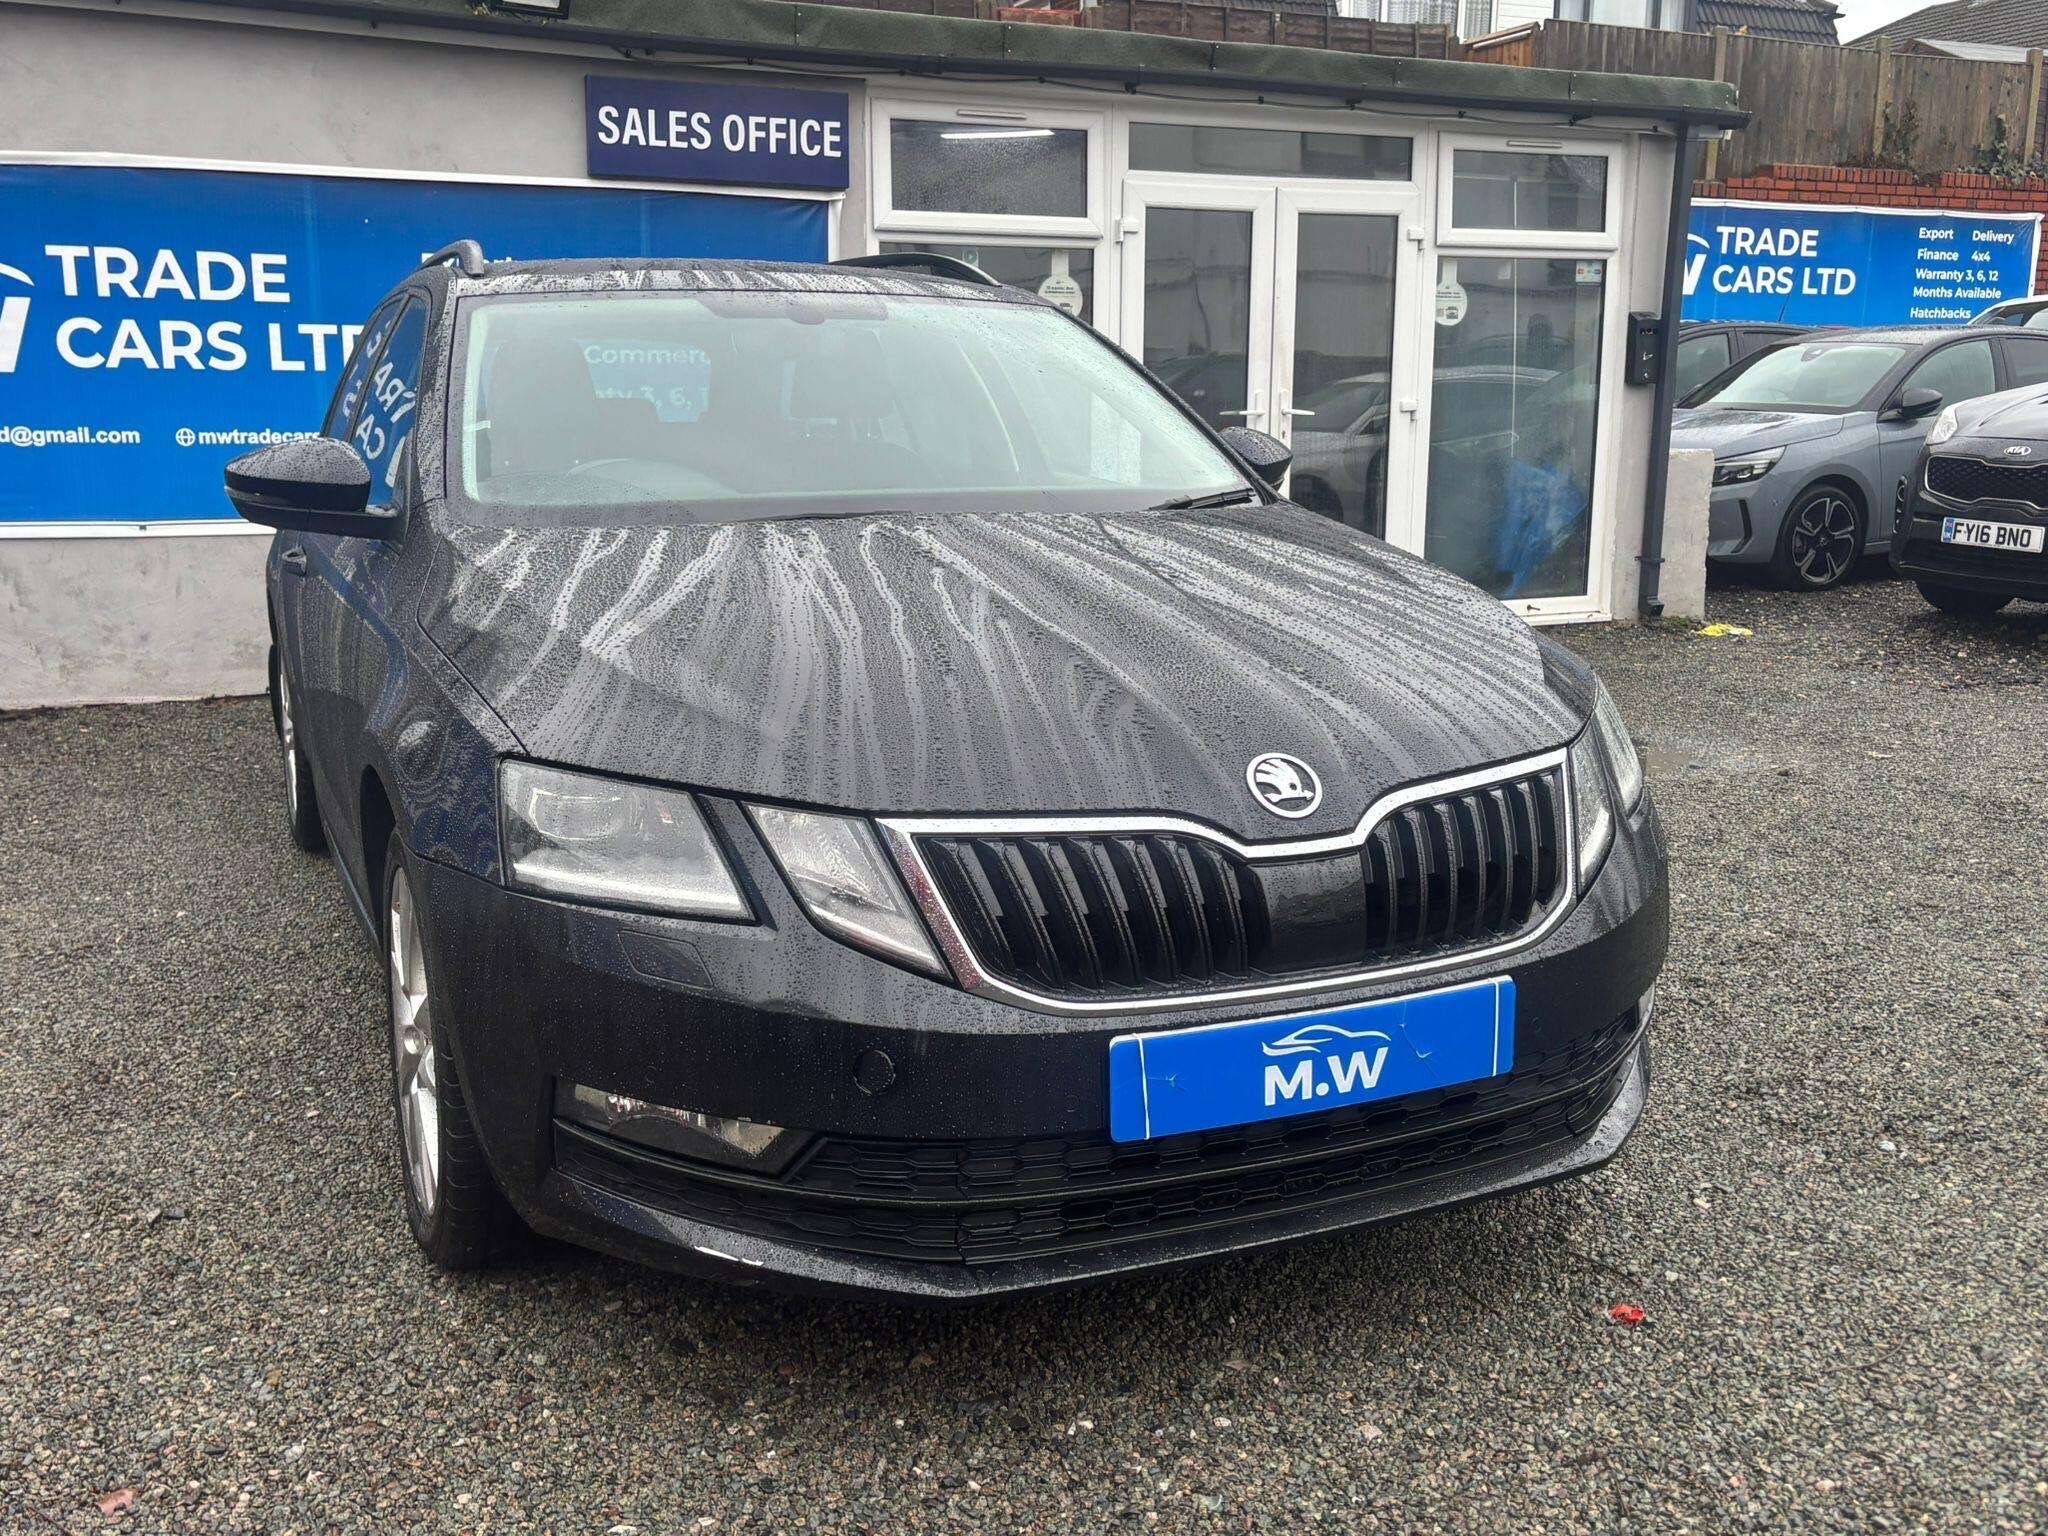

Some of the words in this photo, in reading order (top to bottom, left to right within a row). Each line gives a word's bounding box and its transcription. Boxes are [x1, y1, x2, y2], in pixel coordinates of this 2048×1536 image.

[598, 105, 712, 150] SALES
[722, 114, 842, 158] OFFICE
[1716, 225, 1820, 257] TRADE
[1918, 227, 1954, 241] Export
[1972, 230, 2015, 244] Delivery
[1917, 248, 1960, 261] Finance
[1971, 250, 1991, 262] 4x4
[45, 244, 291, 303] TRADE
[1712, 264, 1794, 295] CARS
[1802, 267, 1857, 296] LTD
[1915, 268, 1964, 282] Warranty
[1965, 269, 1975, 282] 3,
[1976, 269, 1986, 282] 6,
[1988, 270, 1999, 281] 12
[1913, 286, 1953, 298] Months
[1954, 287, 2002, 299] Available
[1910, 307, 1971, 319] Hatchbacks
[56, 317, 248, 372] CARS
[1952, 522, 1991, 544] FY16
[1995, 526, 2032, 548] BNO
[1264, 1046, 1389, 1106] M.W
